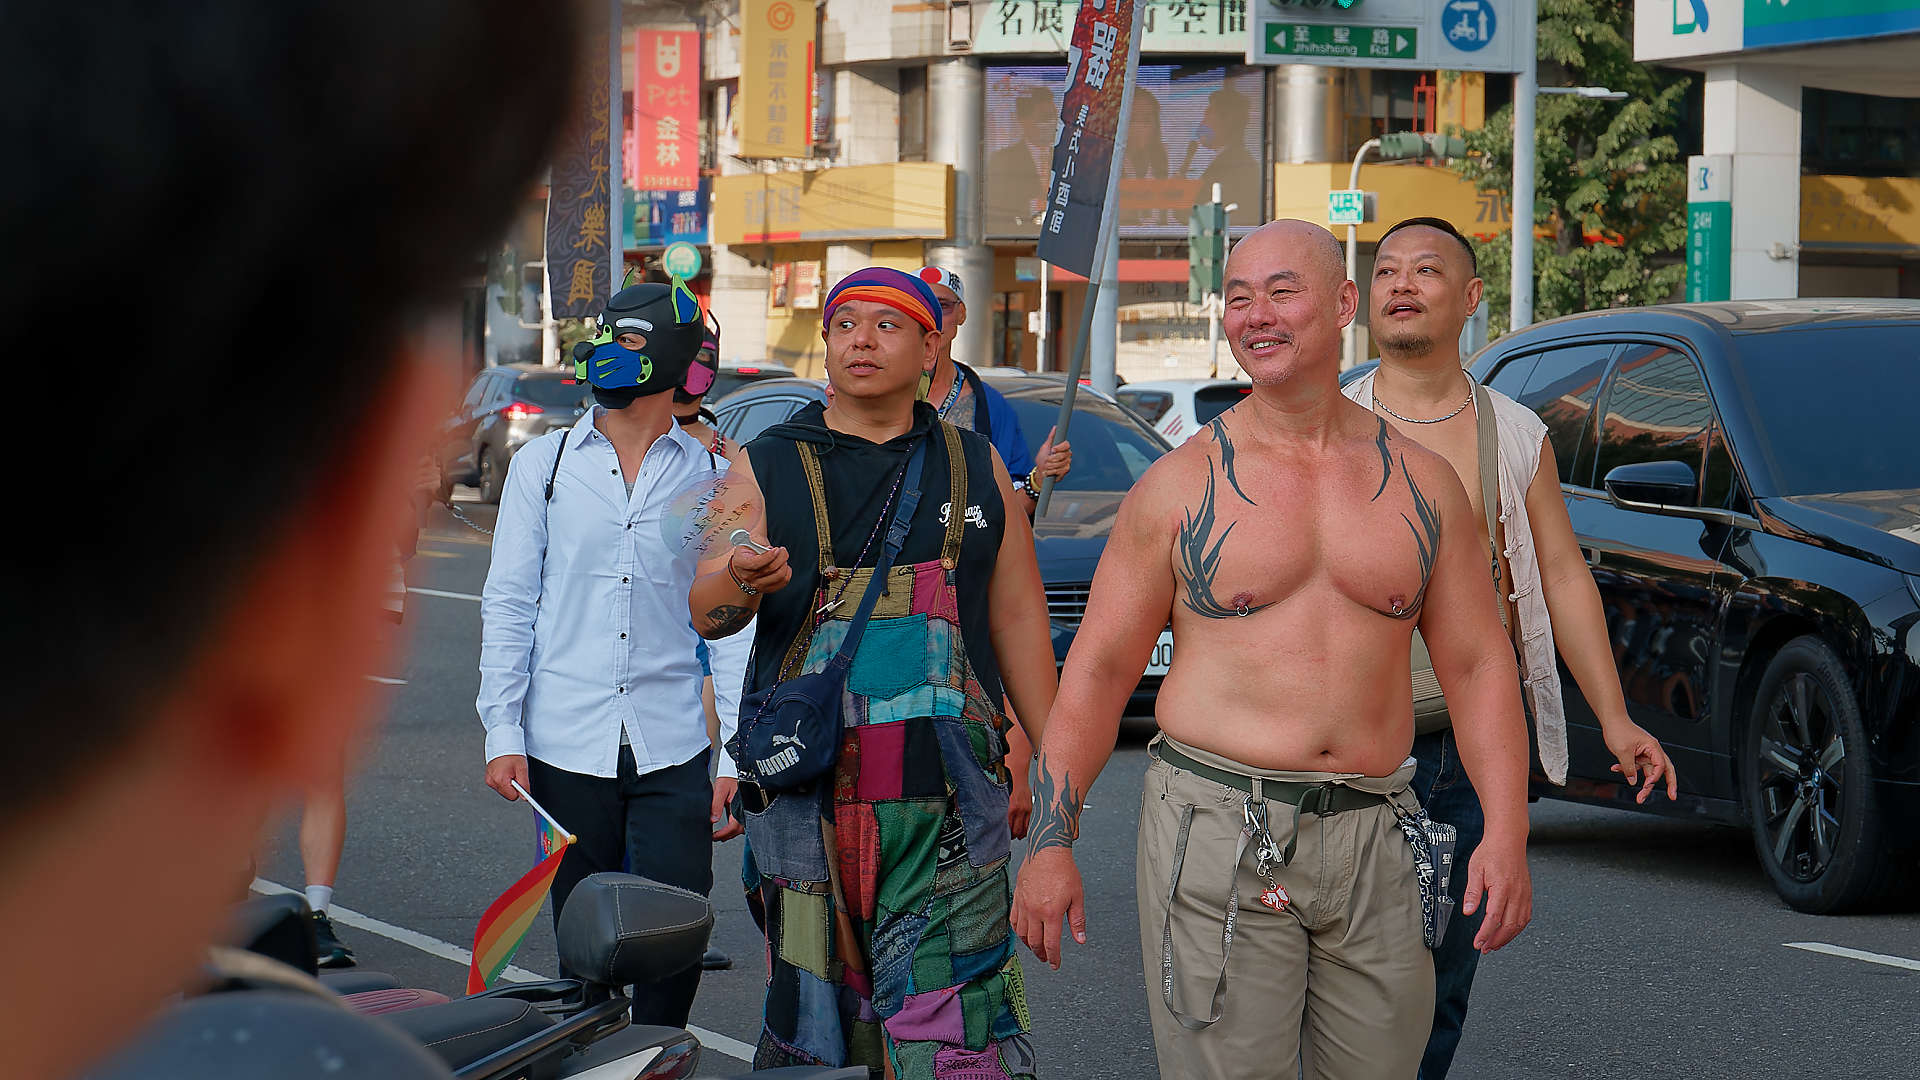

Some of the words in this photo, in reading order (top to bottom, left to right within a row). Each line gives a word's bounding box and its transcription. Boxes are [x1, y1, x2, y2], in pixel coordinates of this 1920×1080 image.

[1294, 25, 1389, 44] 至聖路
[646, 83, 693, 106] Pet
[656, 116, 680, 166] 金林
[756, 746, 801, 776] PUMA
